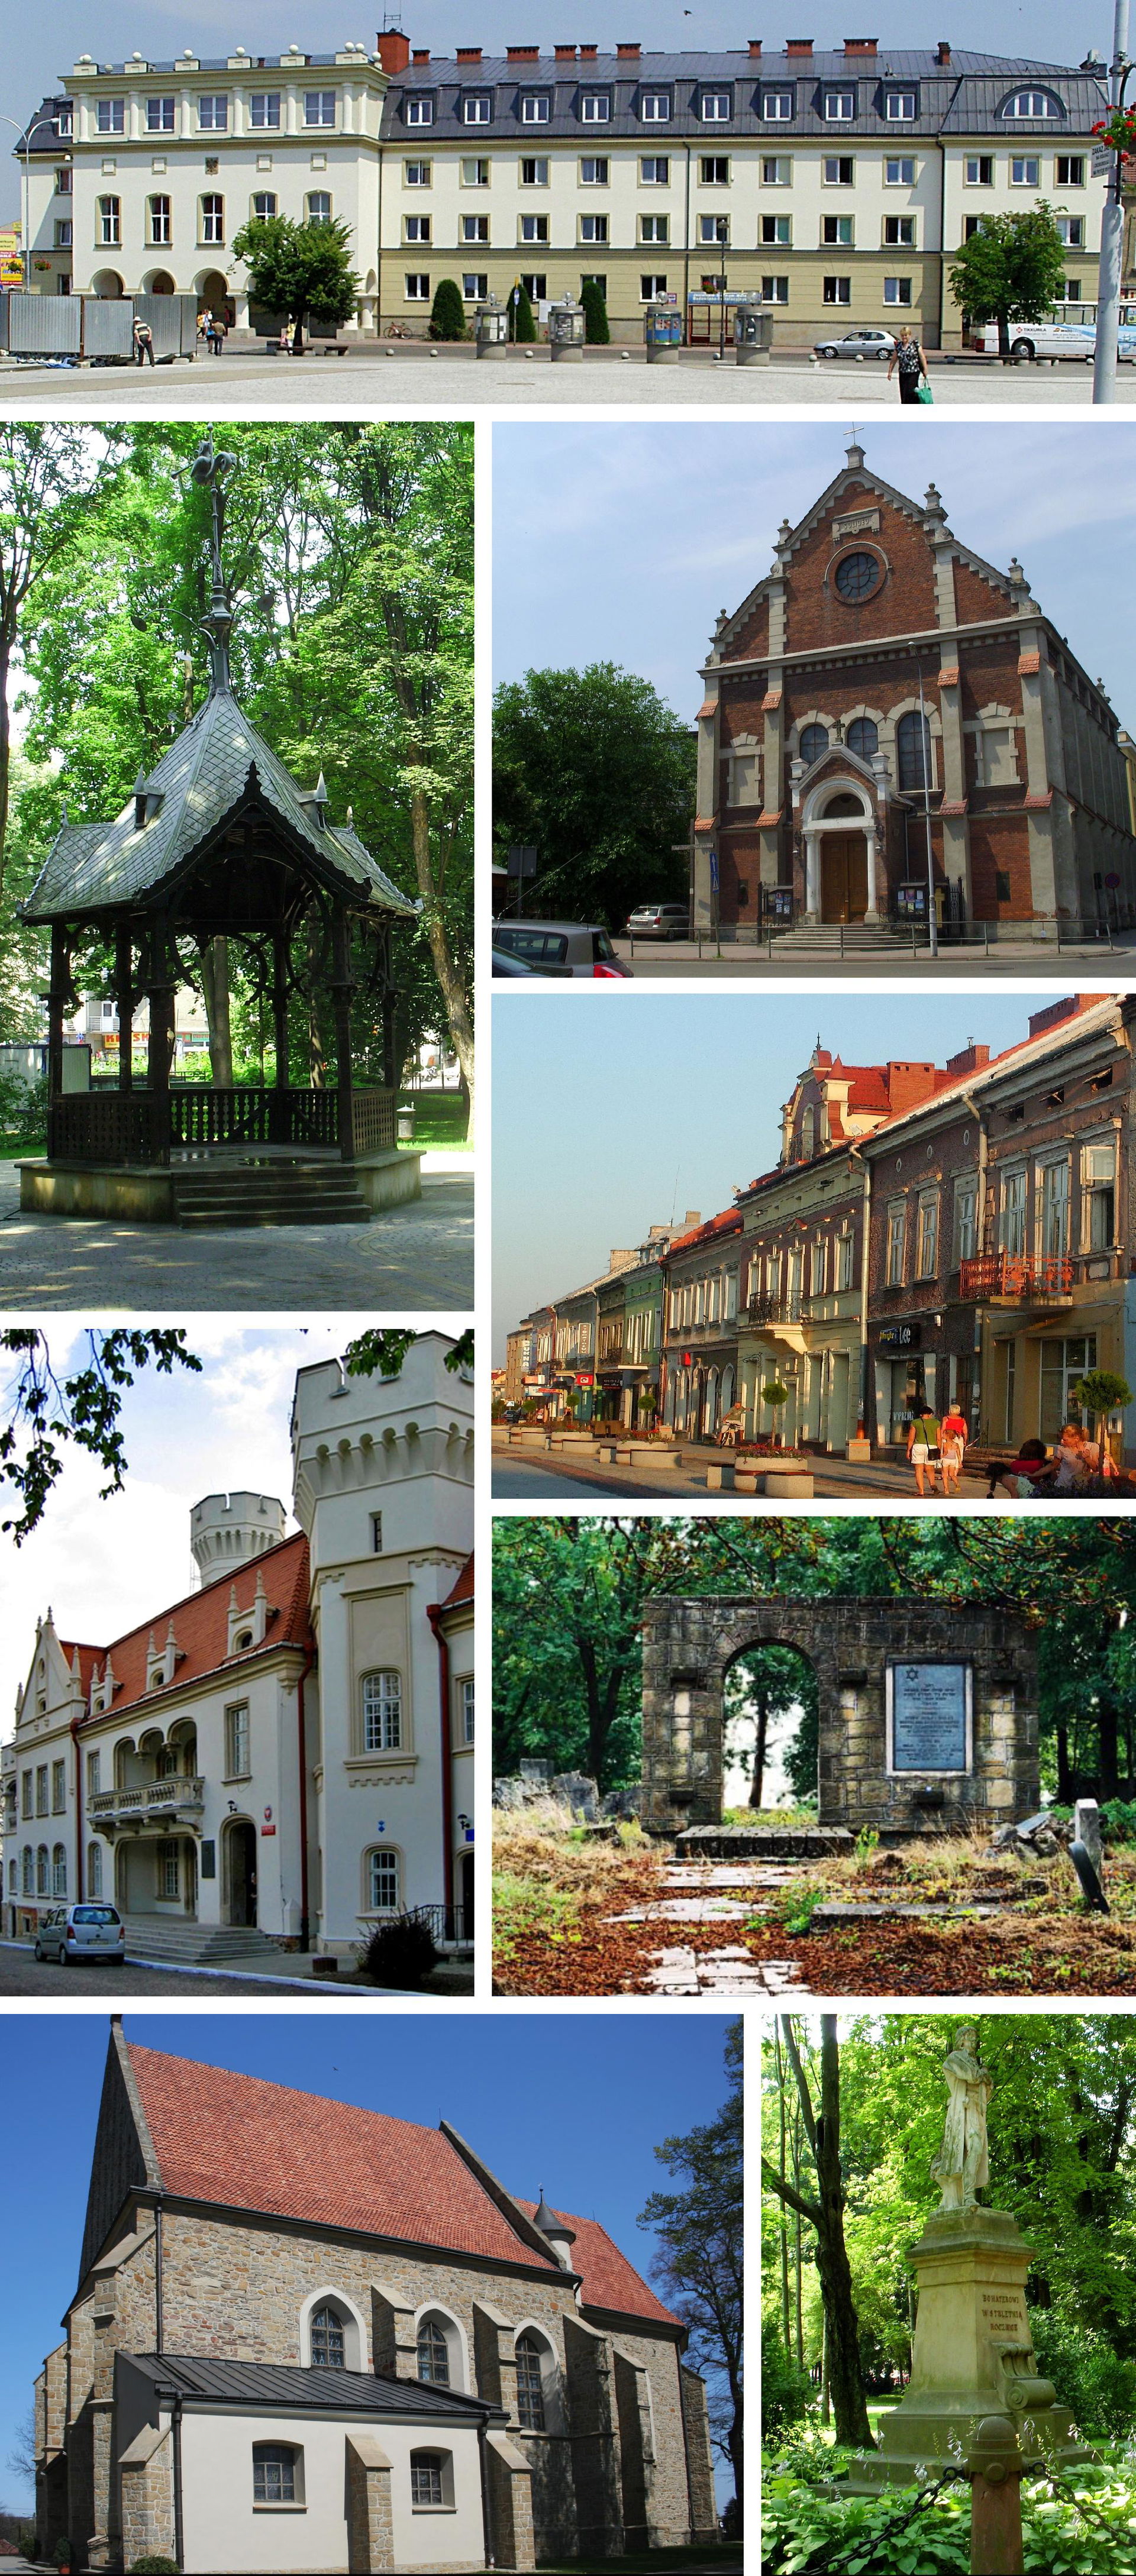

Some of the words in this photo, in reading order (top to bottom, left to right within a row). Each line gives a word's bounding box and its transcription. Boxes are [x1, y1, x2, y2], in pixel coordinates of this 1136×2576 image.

[106, 1033, 149, 1042] KISK
[899, 1326, 911, 1344] Lee
[983, 2294, 1019, 2303] BOHATEROWI
